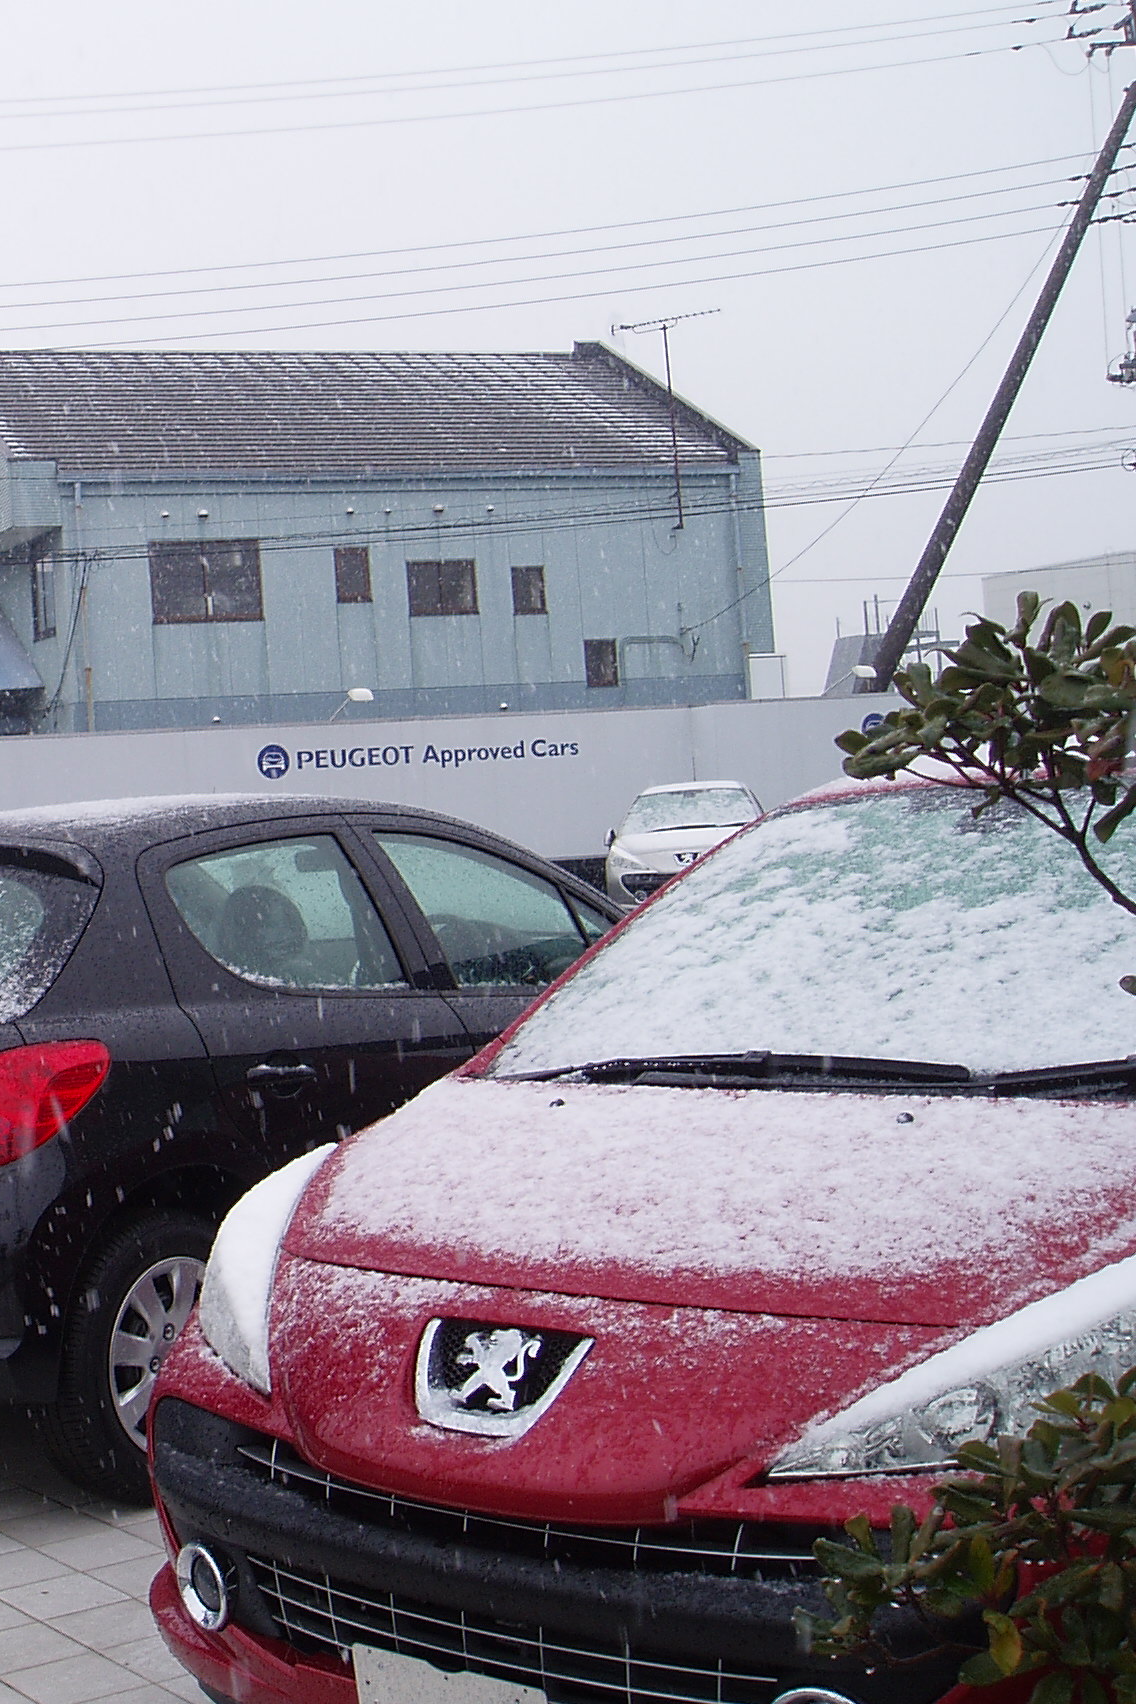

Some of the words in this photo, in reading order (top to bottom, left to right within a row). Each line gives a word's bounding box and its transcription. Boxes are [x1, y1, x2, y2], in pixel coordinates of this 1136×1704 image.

[297, 745, 414, 769] PEUGEOT
[422, 740, 524, 768] Approved
[531, 739, 579, 758] Cars
